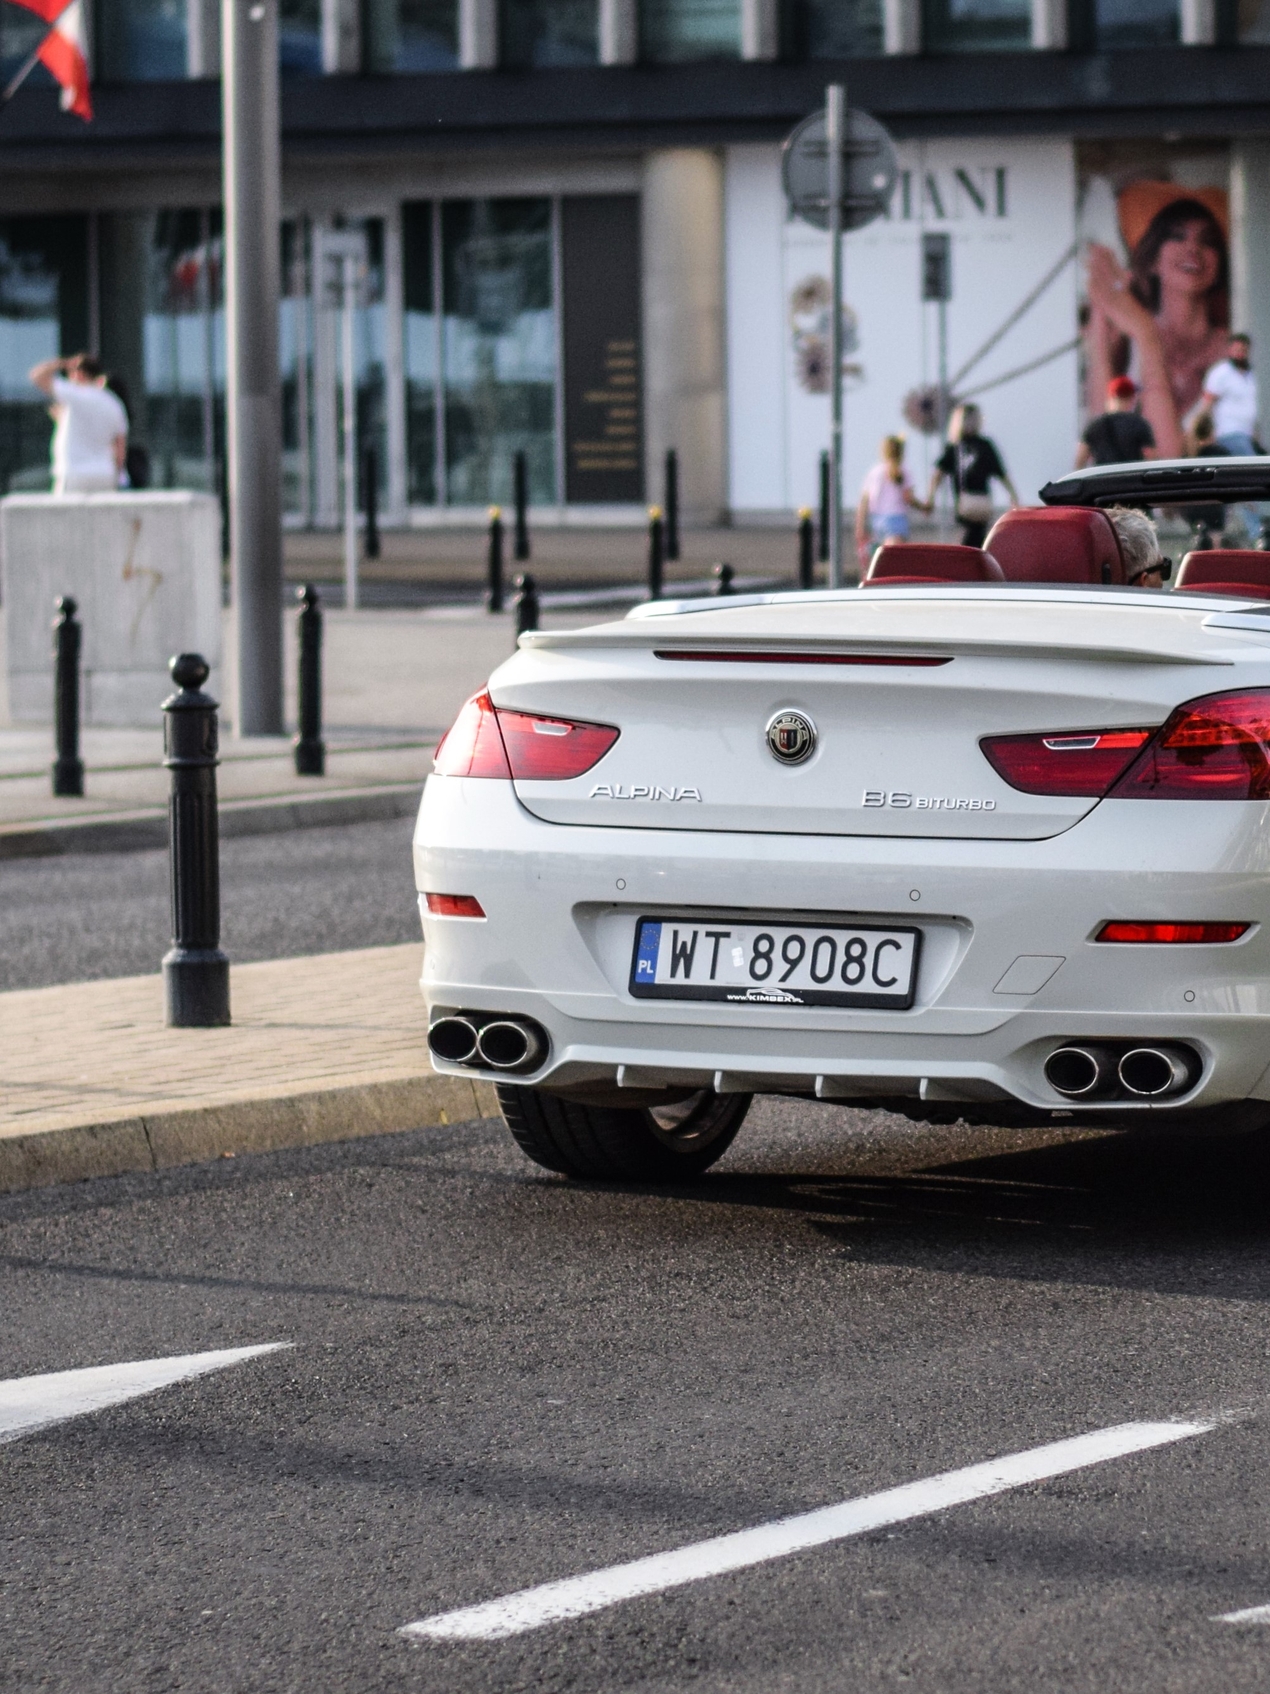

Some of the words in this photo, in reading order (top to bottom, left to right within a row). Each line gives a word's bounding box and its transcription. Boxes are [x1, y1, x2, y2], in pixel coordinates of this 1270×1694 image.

[771, 717, 808, 741] ALPINA
[589, 784, 702, 802] ALPINA
[862, 789, 912, 808] B6
[915, 797, 996, 811] BITURBO
[638, 960, 653, 974] PL
[669, 929, 732, 980] WT
[749, 933, 903, 987] 8908C
